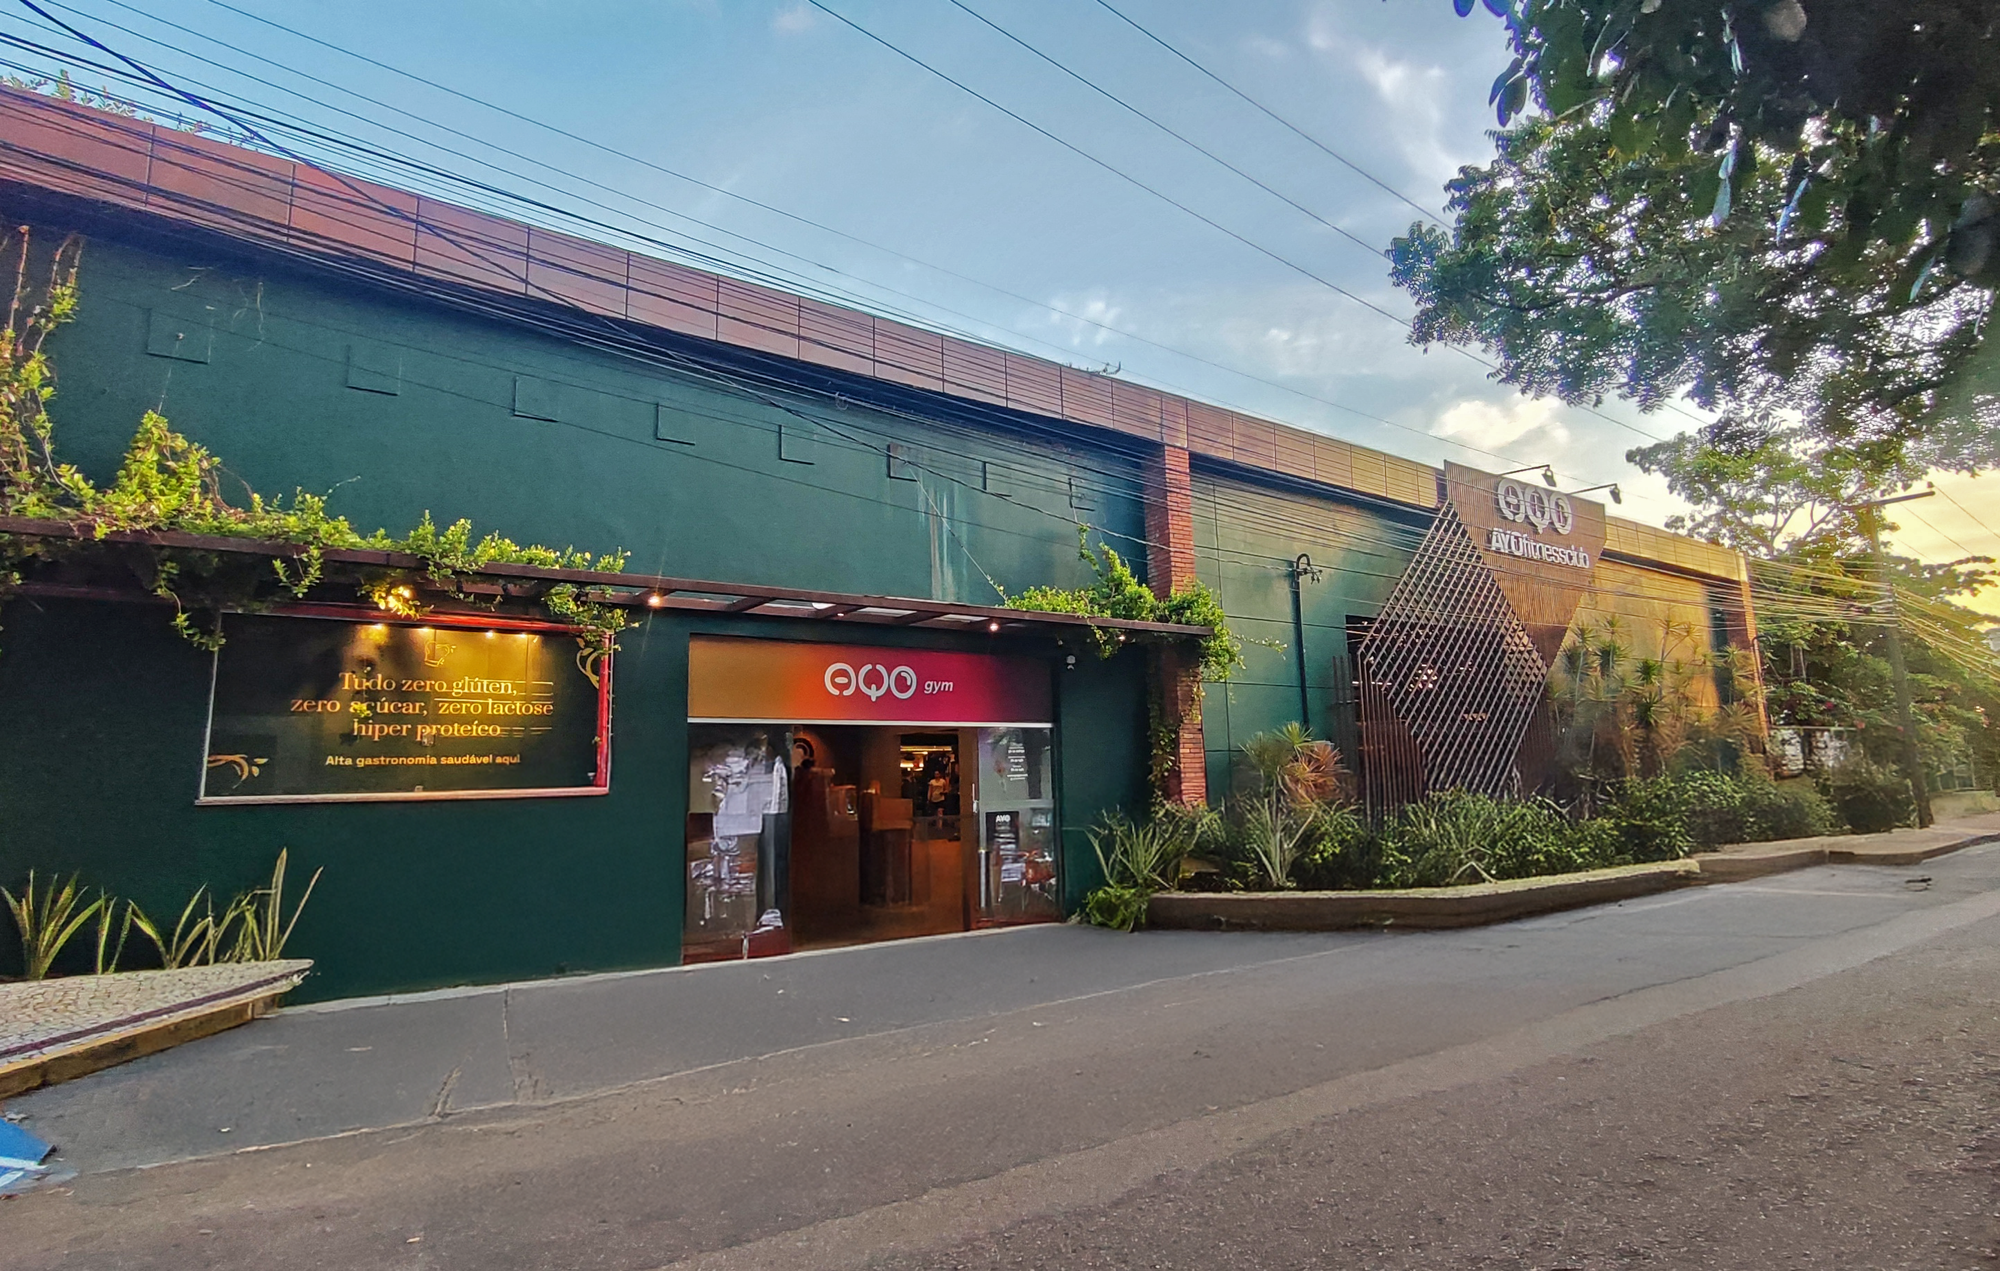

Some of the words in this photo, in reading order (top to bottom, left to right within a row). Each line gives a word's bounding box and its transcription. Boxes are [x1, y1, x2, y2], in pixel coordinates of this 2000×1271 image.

[339, 672, 396, 692] Tudo
[401, 680, 447, 692] zero
[452, 677, 518, 696] glúten,
[924, 681, 954, 694] gym
[290, 699, 341, 712] zero
[438, 702, 482, 715] zero
[488, 700, 554, 716] lactose
[353, 718, 411, 741] hiper
[416, 720, 501, 741] proteíco
[325, 755, 353, 766] Alta
[356, 755, 437, 768] gastronomia
[440, 754, 493, 765] saudável
[495, 754, 521, 765] aqui
